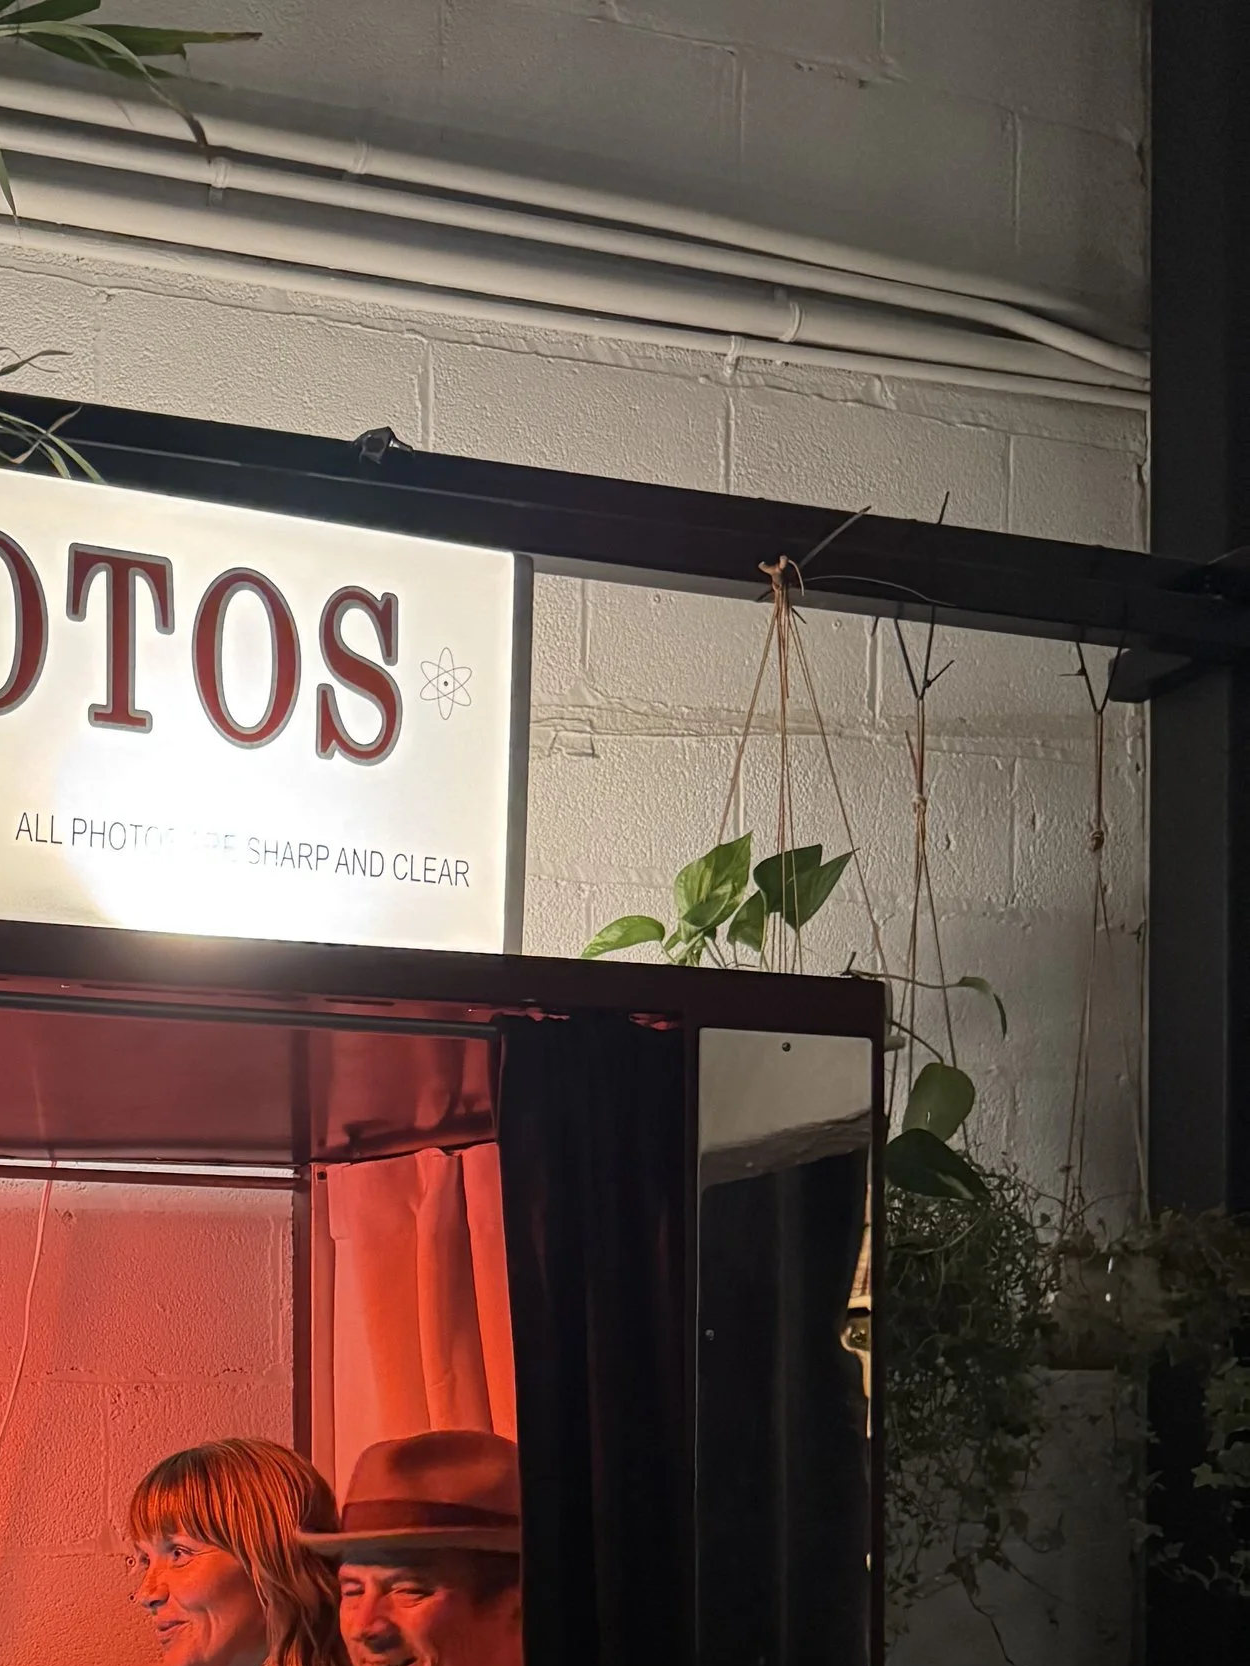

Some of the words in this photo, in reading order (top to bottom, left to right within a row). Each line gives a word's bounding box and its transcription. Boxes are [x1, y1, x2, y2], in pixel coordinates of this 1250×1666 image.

[15, 811, 63, 846] ALL
[247, 836, 331, 872] SHARP
[334, 847, 385, 878] AND
[392, 852, 471, 888] CLEAR
